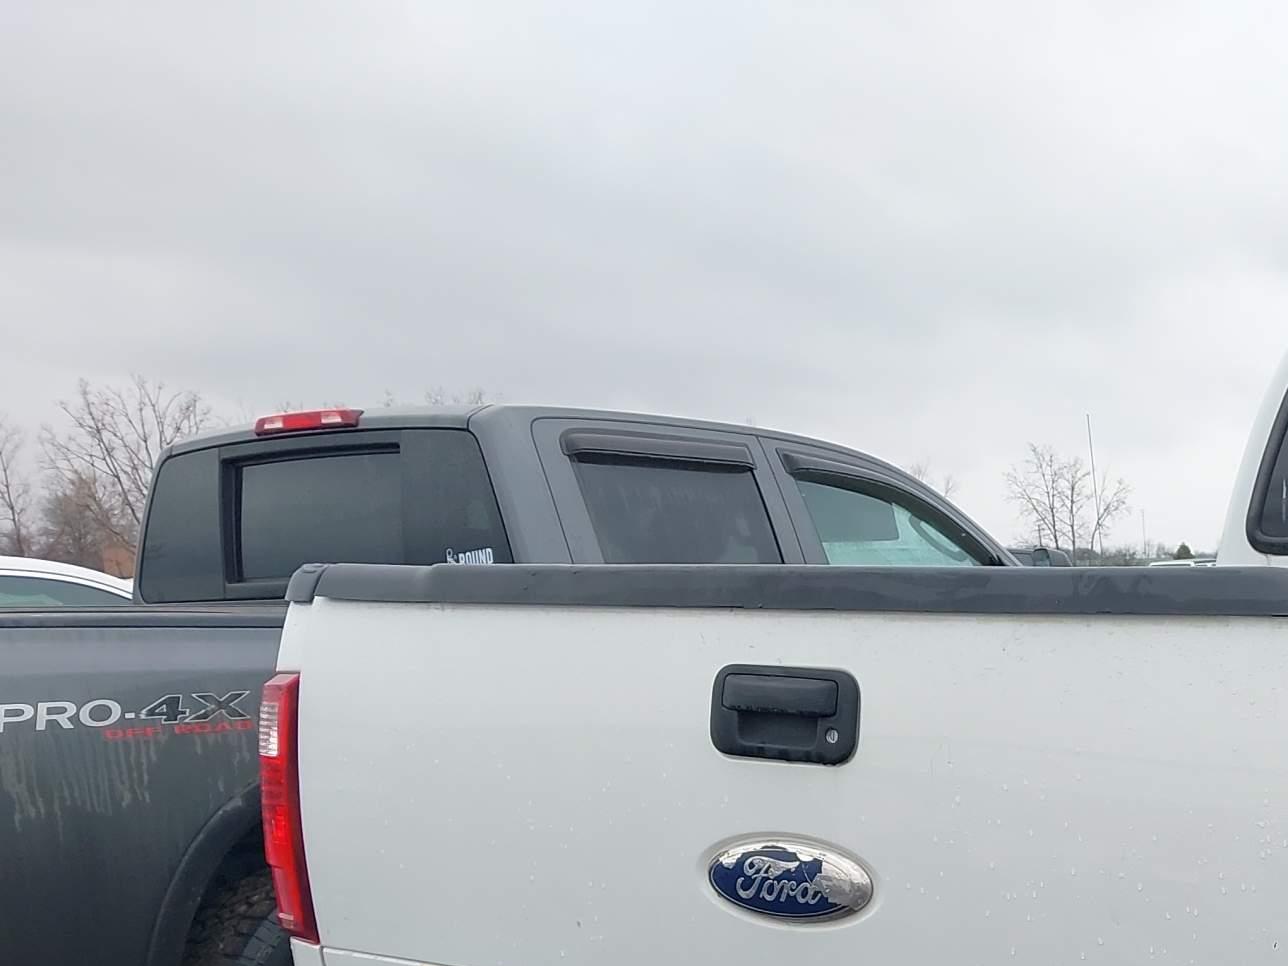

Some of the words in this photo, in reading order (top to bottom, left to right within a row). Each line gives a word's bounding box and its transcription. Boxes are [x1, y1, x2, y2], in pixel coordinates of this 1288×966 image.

[0, 690, 251, 733] PRO-4X
[104, 726, 162, 740] OFF
[174, 719, 255, 735] ROAD
